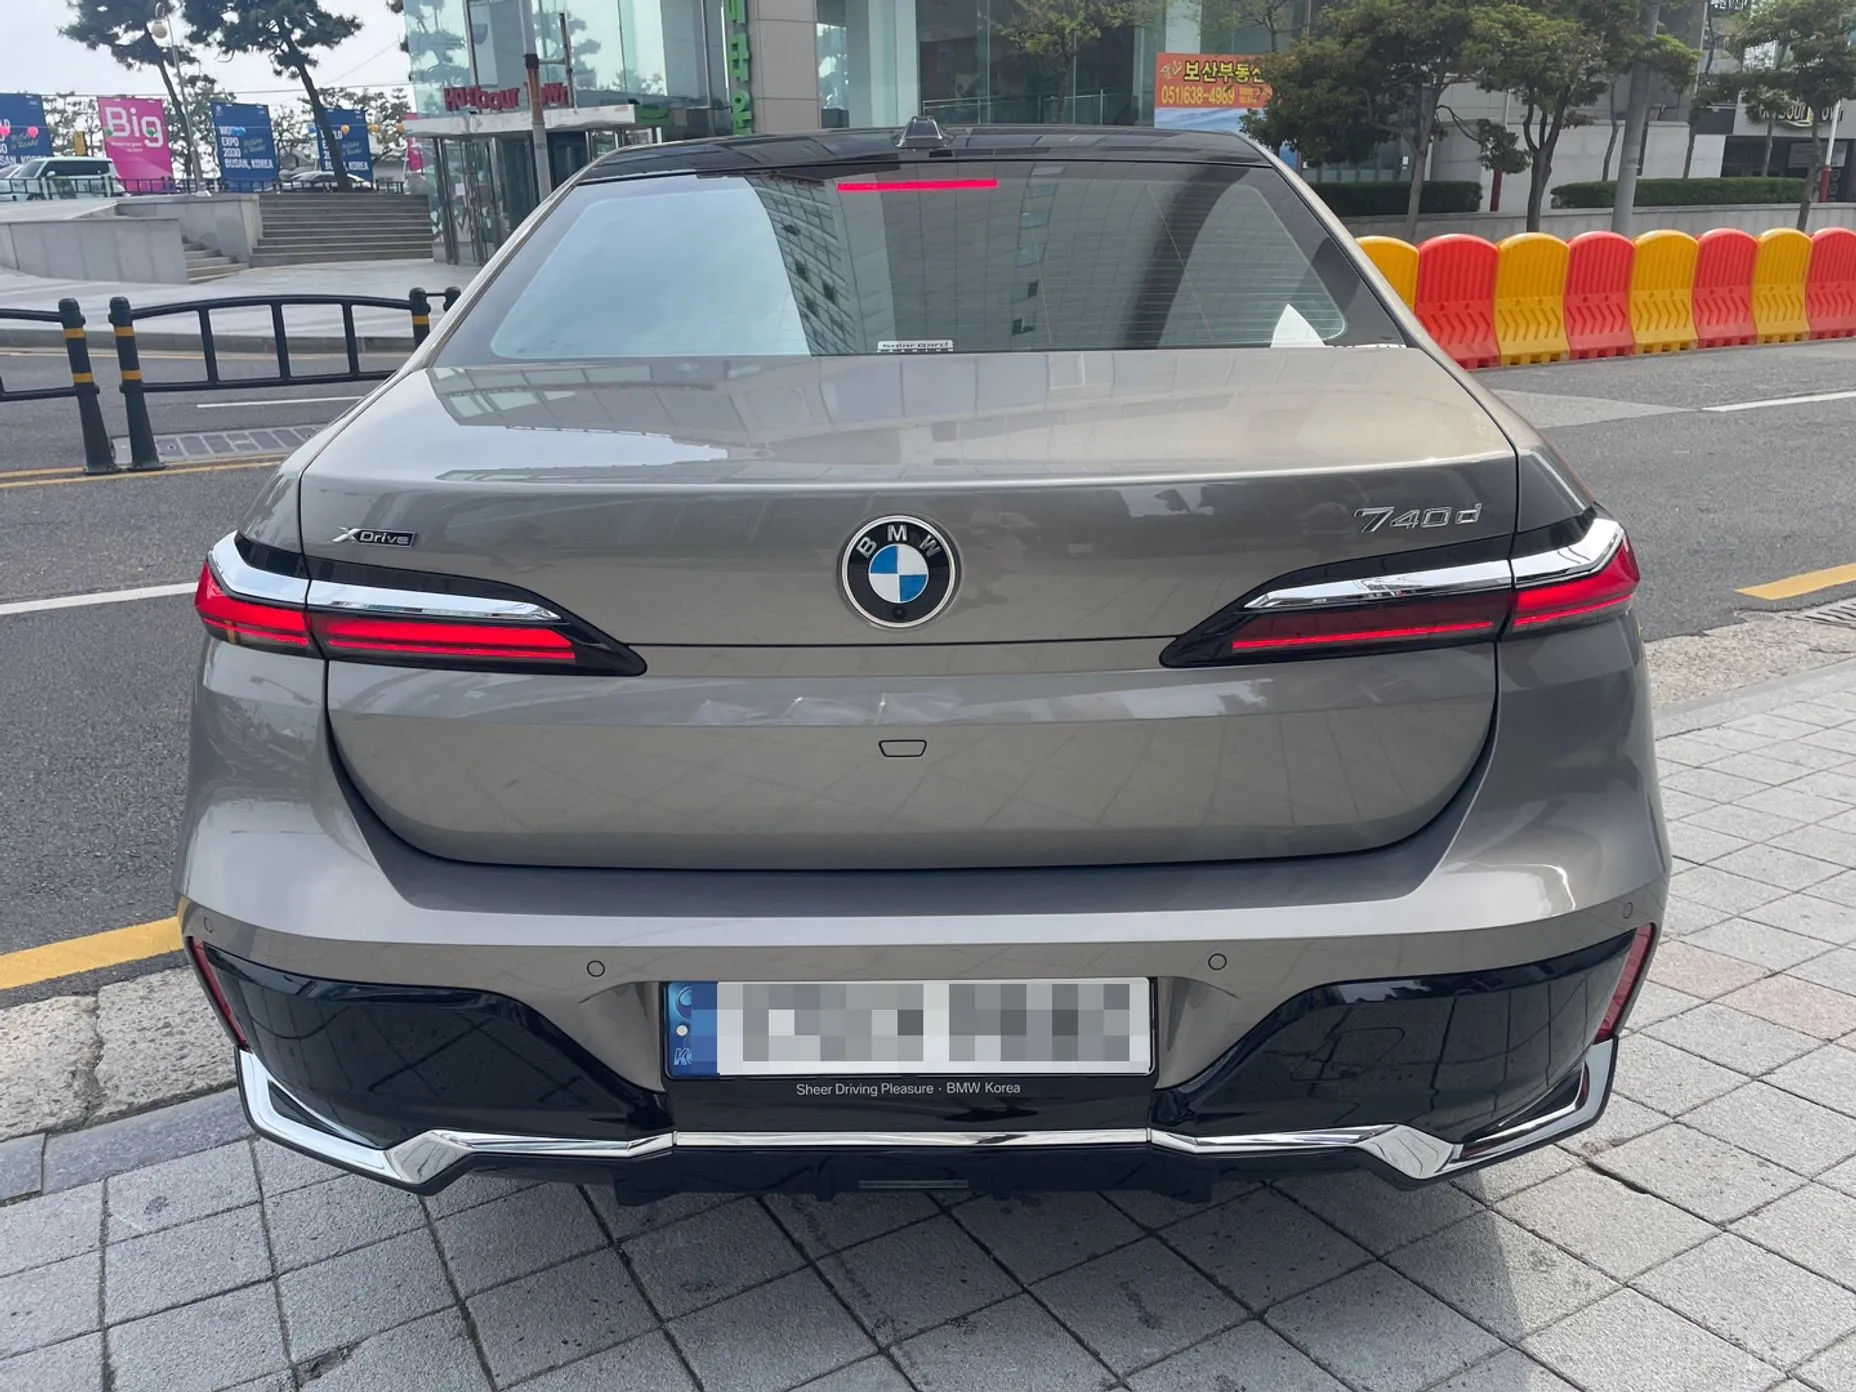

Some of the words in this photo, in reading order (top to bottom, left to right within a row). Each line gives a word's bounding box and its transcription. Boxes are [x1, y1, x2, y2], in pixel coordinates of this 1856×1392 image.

[105, 107, 164, 148] Big
[221, 137, 240, 147] EXPO
[251, 158, 274, 169] KOREA
[856, 524, 942, 559] BMW
[796, 1083, 833, 1096] Sheer
[835, 1083, 878, 1097] Driving
[881, 1082, 934, 1095] Pleasure
[946, 1082, 981, 1094] BMW
[985, 1081, 1021, 1094] Korea
